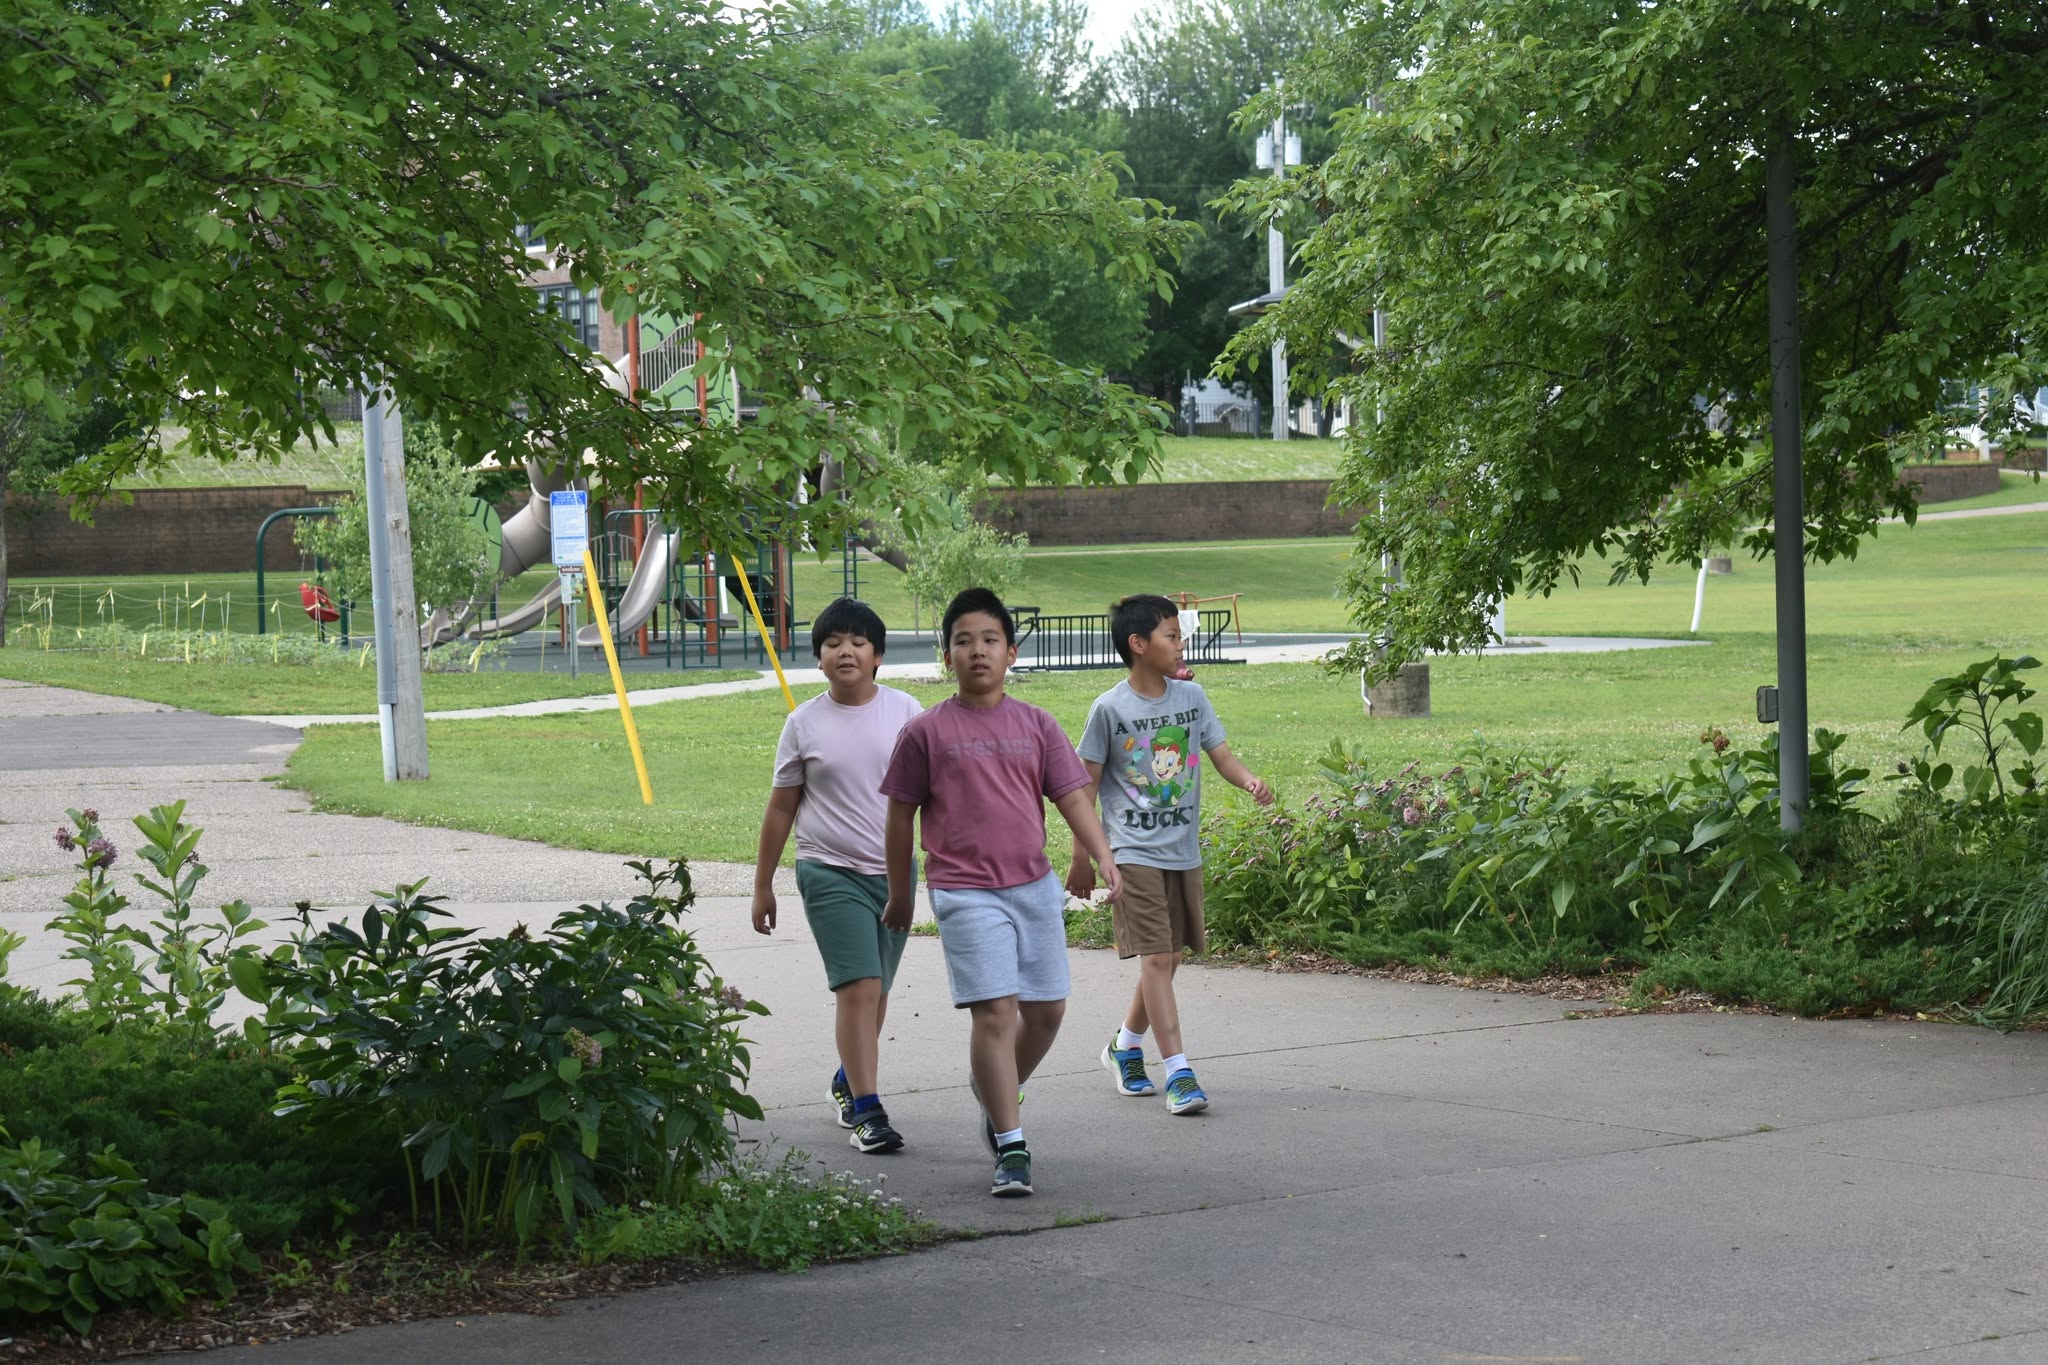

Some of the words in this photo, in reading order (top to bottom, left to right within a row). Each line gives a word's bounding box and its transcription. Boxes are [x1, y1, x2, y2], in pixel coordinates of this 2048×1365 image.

[1115, 723, 1129, 735] A
[1132, 715, 1171, 732] WEE
[1174, 708, 1199, 726] BIT
[1124, 806, 1193, 830] LUCK
